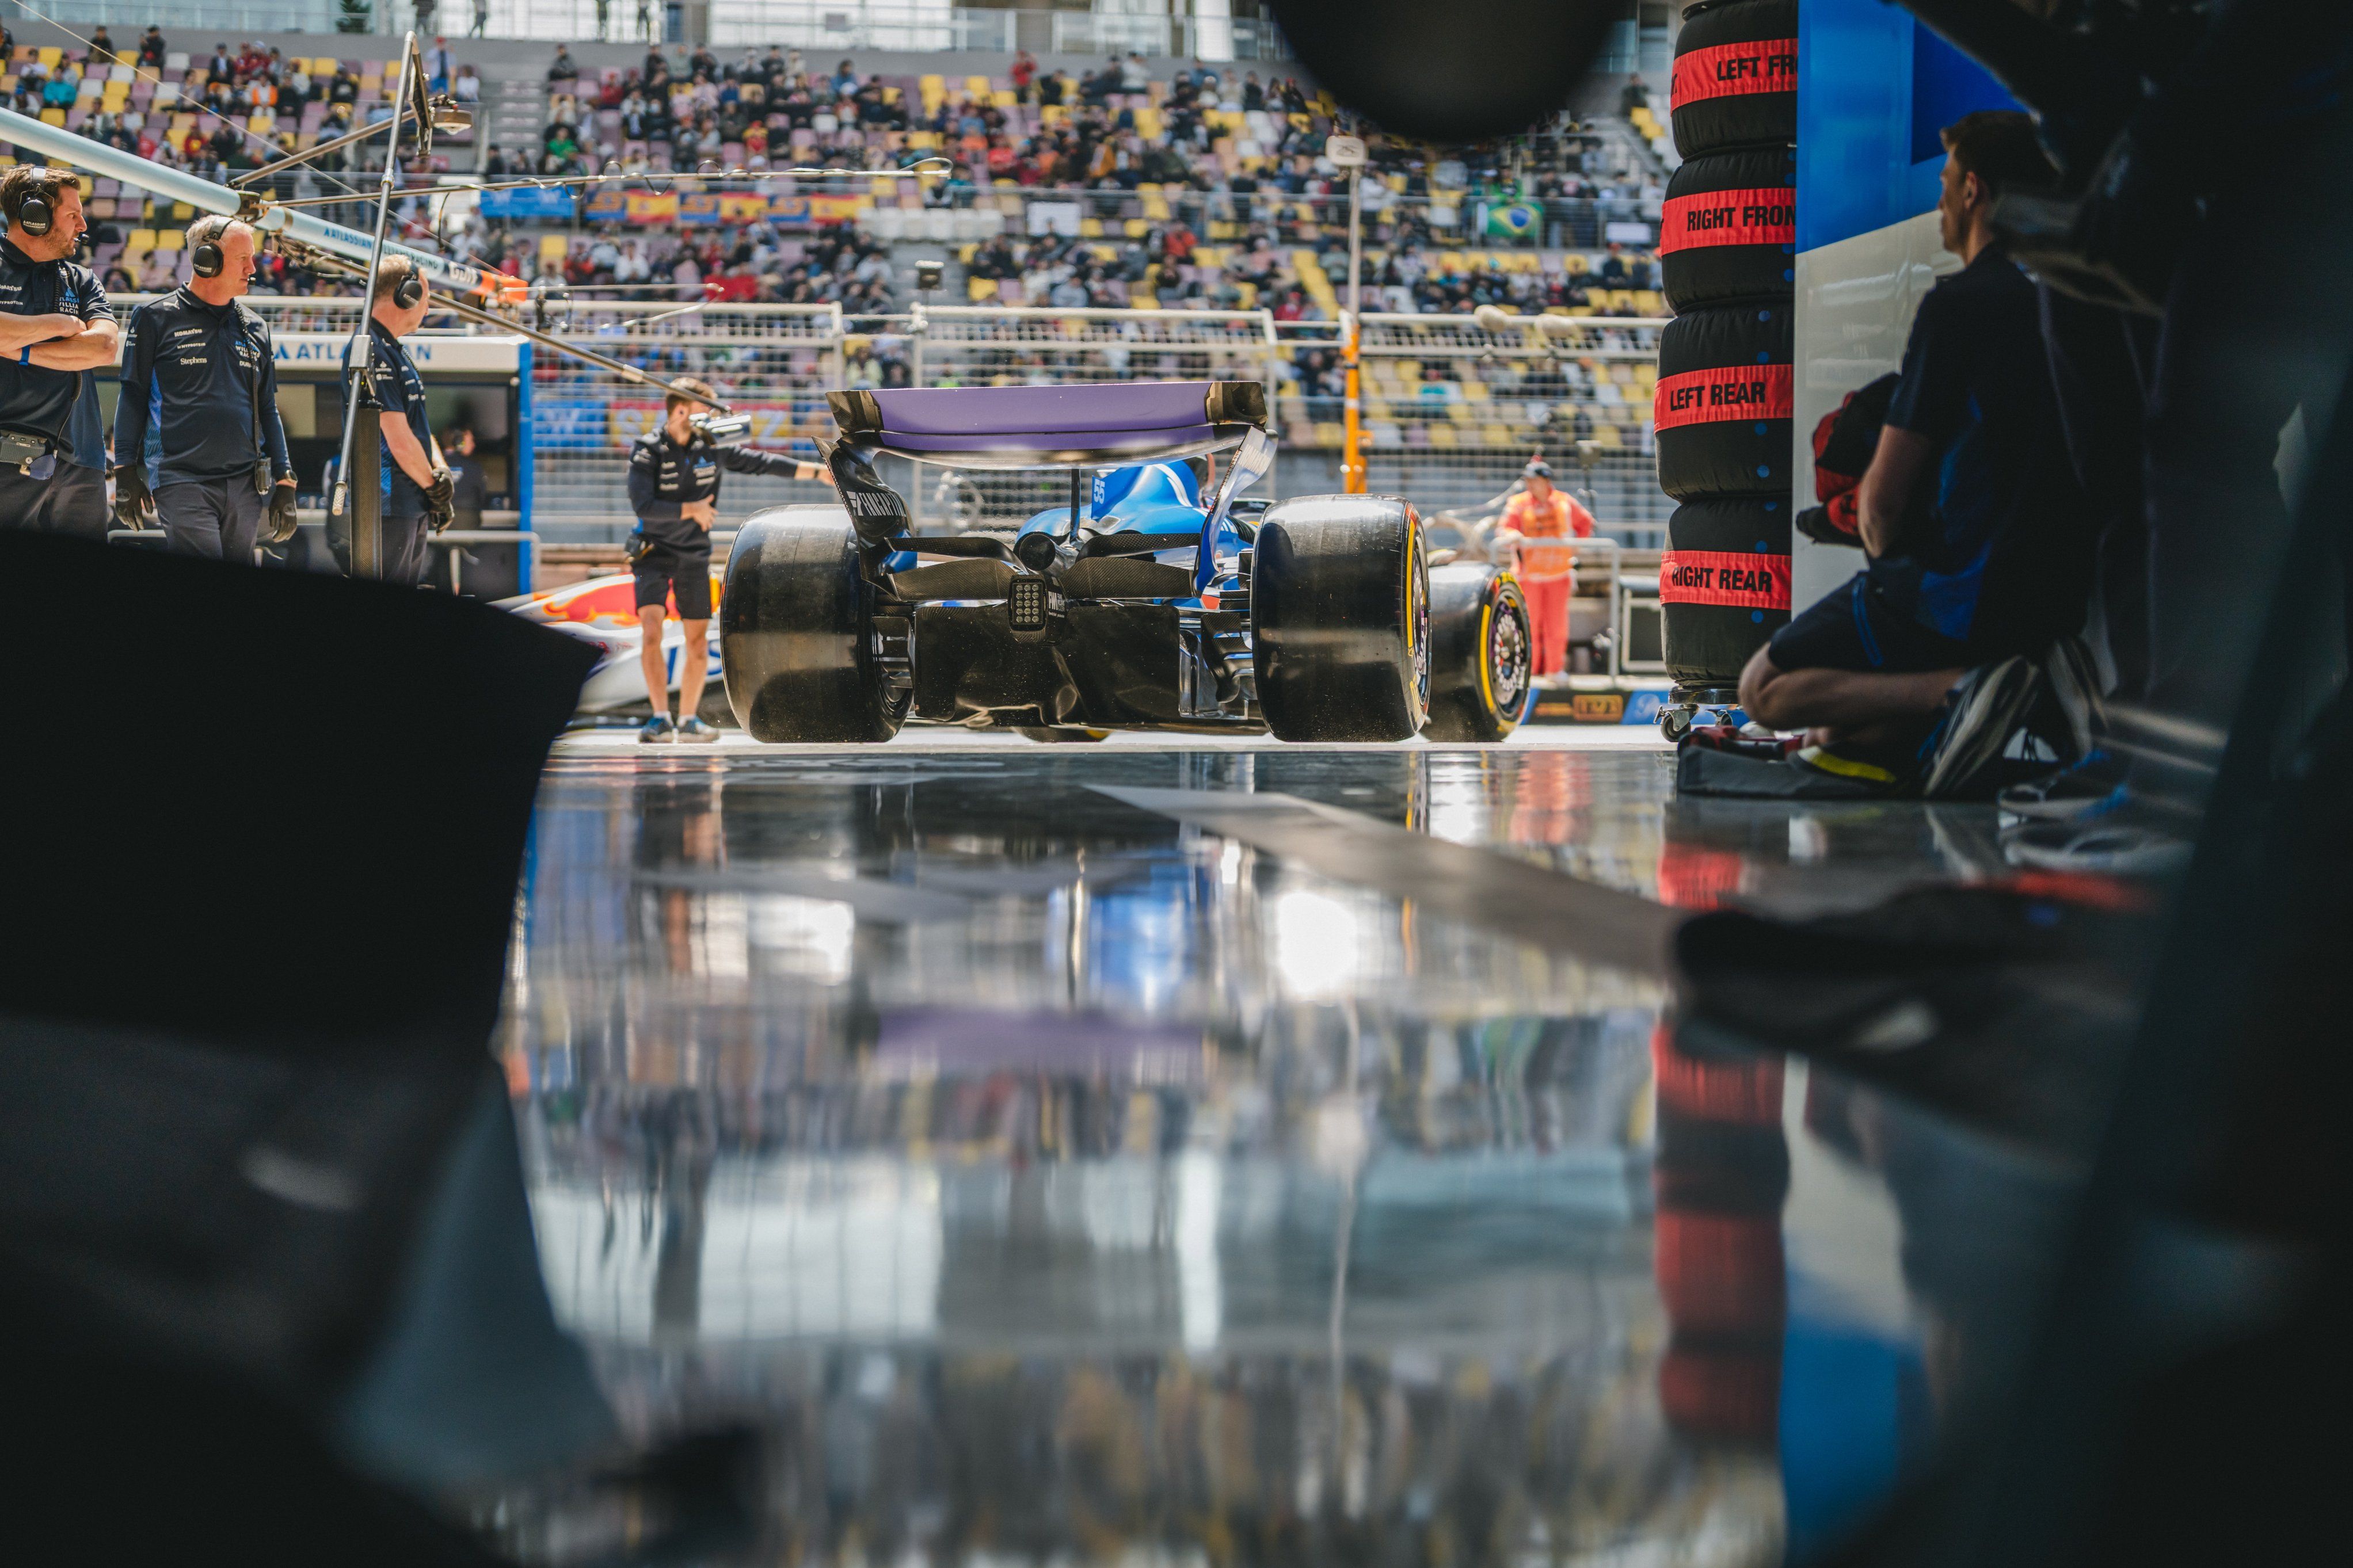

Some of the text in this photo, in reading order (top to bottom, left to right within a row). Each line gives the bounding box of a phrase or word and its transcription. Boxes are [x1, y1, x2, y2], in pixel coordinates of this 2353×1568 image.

[1717, 54, 1798, 81] LEFT FR
[1687, 205, 1796, 232] RIGHT FRON
[331, 228, 372, 249] ATLASSIAN
[59, 307, 79, 315] RACIN
[174, 328, 203, 337] KOMATSU
[180, 357, 208, 365] Stephens
[1670, 381, 1765, 411] LEFT REAR
[1094, 478, 1105, 505] 55
[1672, 566, 1773, 593] RIGHT REAR
